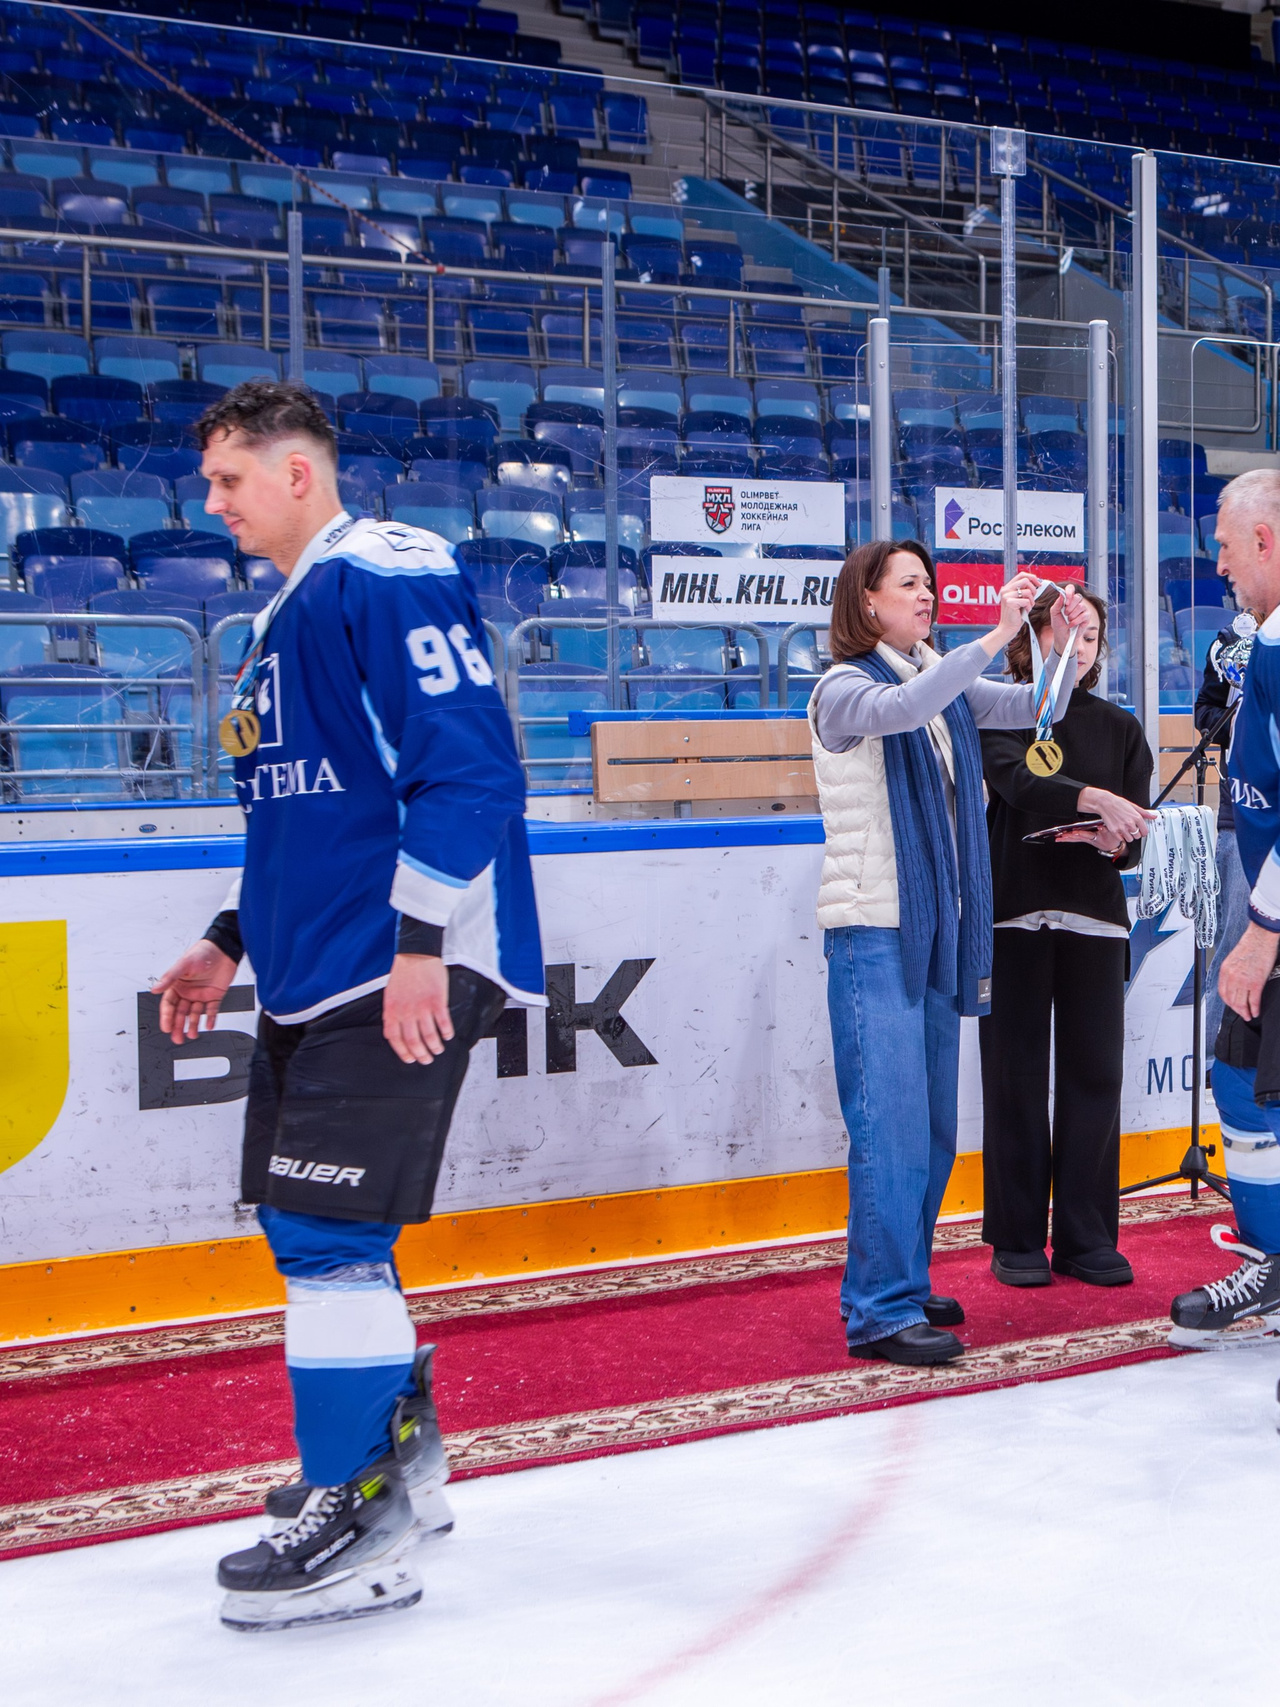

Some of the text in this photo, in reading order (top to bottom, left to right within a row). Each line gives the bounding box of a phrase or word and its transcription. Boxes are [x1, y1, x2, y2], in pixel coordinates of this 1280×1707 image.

[706, 493, 731, 503] МХЛ
[740, 490, 780, 500] OLIMPBET
[740, 502, 798, 512] МОЛОДЕЖНАЯ
[740, 511, 789, 522] ХОККЕЙНАЯ
[740, 523, 762, 531] ЛИГА
[968, 517, 1076, 539] Роселеком
[659, 572, 838, 607] MHL.KHL.RU
[942, 584, 1003, 605] OLIM
[136, 956, 660, 1112] БК
